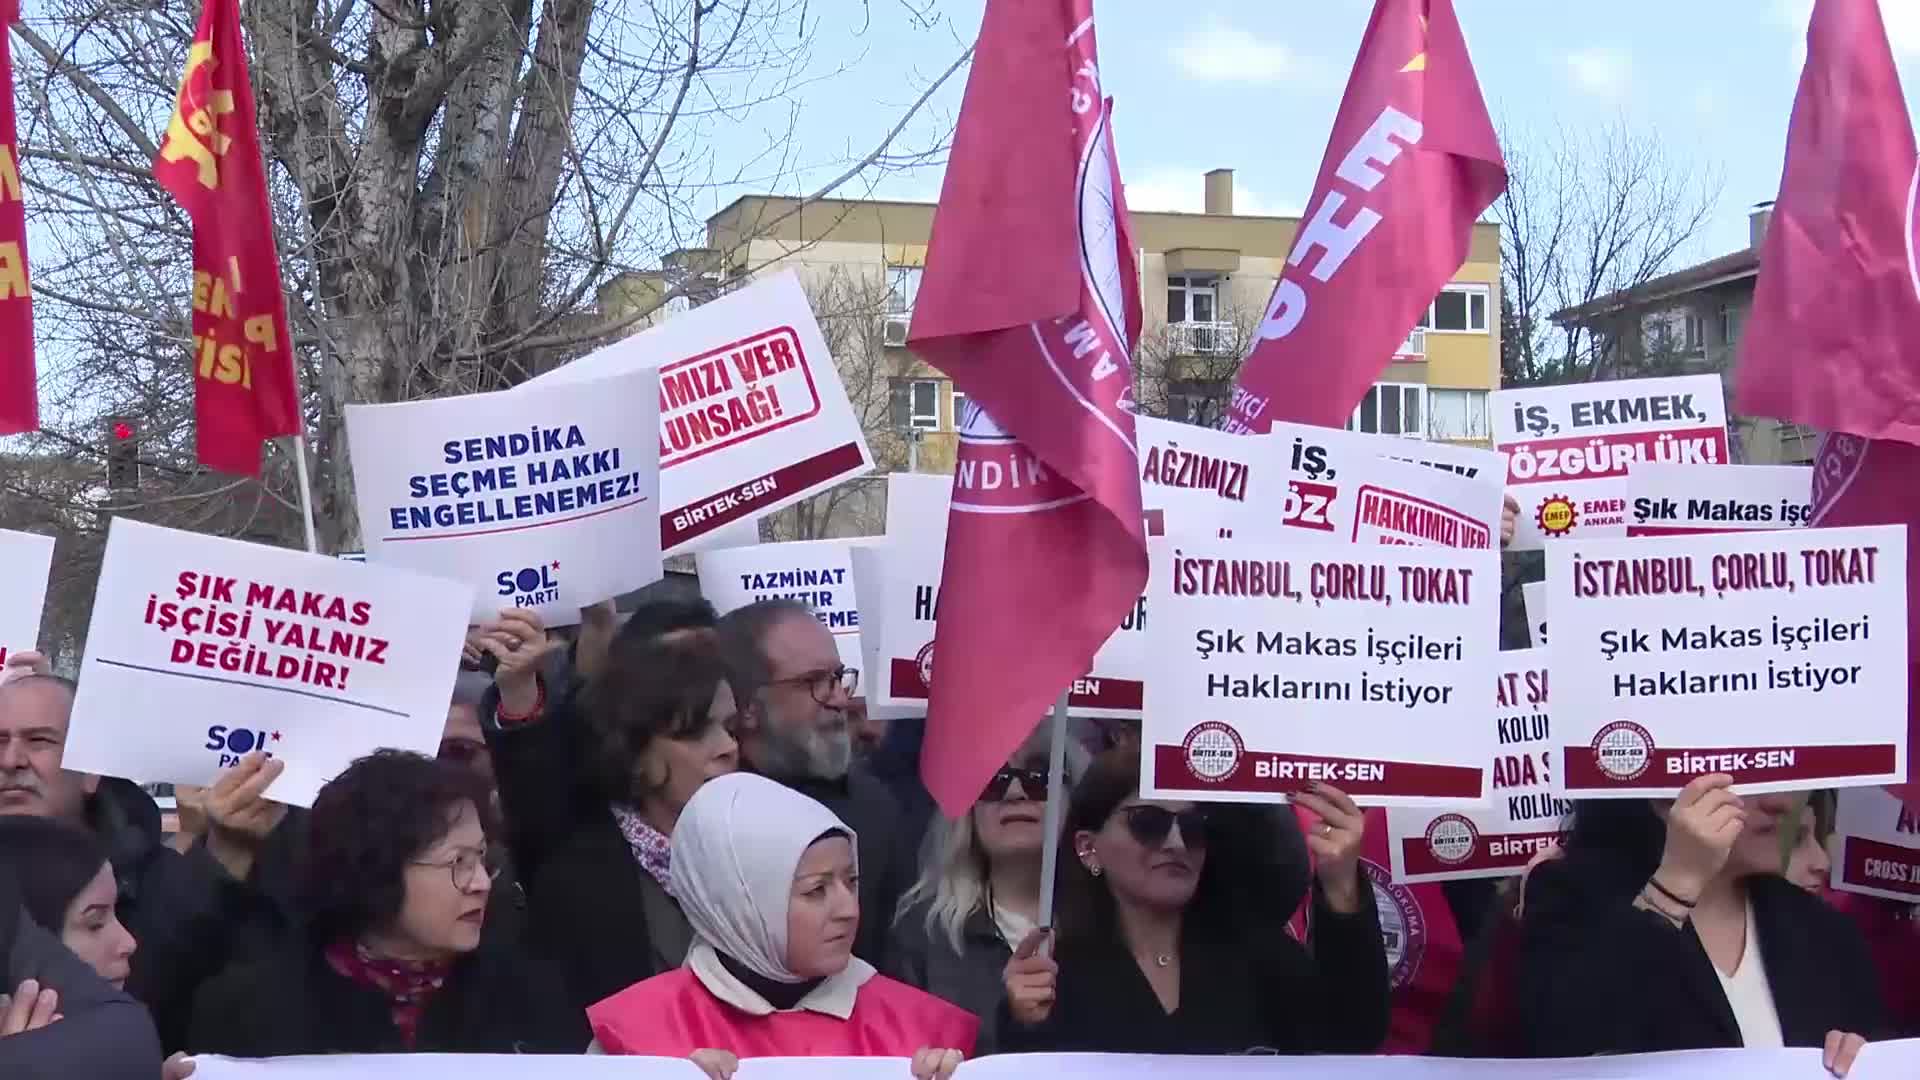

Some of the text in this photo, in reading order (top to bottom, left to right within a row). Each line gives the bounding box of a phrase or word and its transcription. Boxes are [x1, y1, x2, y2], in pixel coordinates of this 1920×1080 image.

[731, 337, 796, 383] VER
[1514, 394, 1706, 436] İŞ, EKMEK,
[443, 425, 585, 464] SENDİKA
[1291, 437, 1336, 480] İŞ,
[1511, 434, 1718, 479] ÖZGÜRLÜK!
[409, 447, 620, 498] SEÇME HAKKI
[1143, 441, 1248, 501] AĞZIMIZI
[390, 472, 641, 530] ENGELLENEMEZ!
[672, 476, 778, 532] BİRTEK-SEN
[1363, 494, 1458, 549] HAKKIMIZI
[1633, 498, 1677, 523] Şık
[1688, 500, 1772, 521] Makas
[741, 568, 846, 590] TAZMİNAT
[1173, 549, 1473, 607] İSTANBUL, ÇORLU, TOKAT
[1573, 547, 1879, 599] İSTANBUL, ÇORLU, TOKAT
[175, 571, 372, 626] ŞIK MAKAS
[145, 594, 390, 664] İŞÇİSİ YALNIZ
[1196, 628, 1463, 665] Şık Makas İşçileri
[1600, 615, 1869, 661] Şık Makas İşçileri
[170, 639, 350, 691] DEĞİLDİR!
[1613, 660, 1862, 698] Haklarını İstiyor
[1207, 672, 1453, 708] Haklarını İstiyor
[1255, 757, 1385, 782] BİRTEK-SEN
[1666, 747, 1796, 775] BİRTEK-SEN
